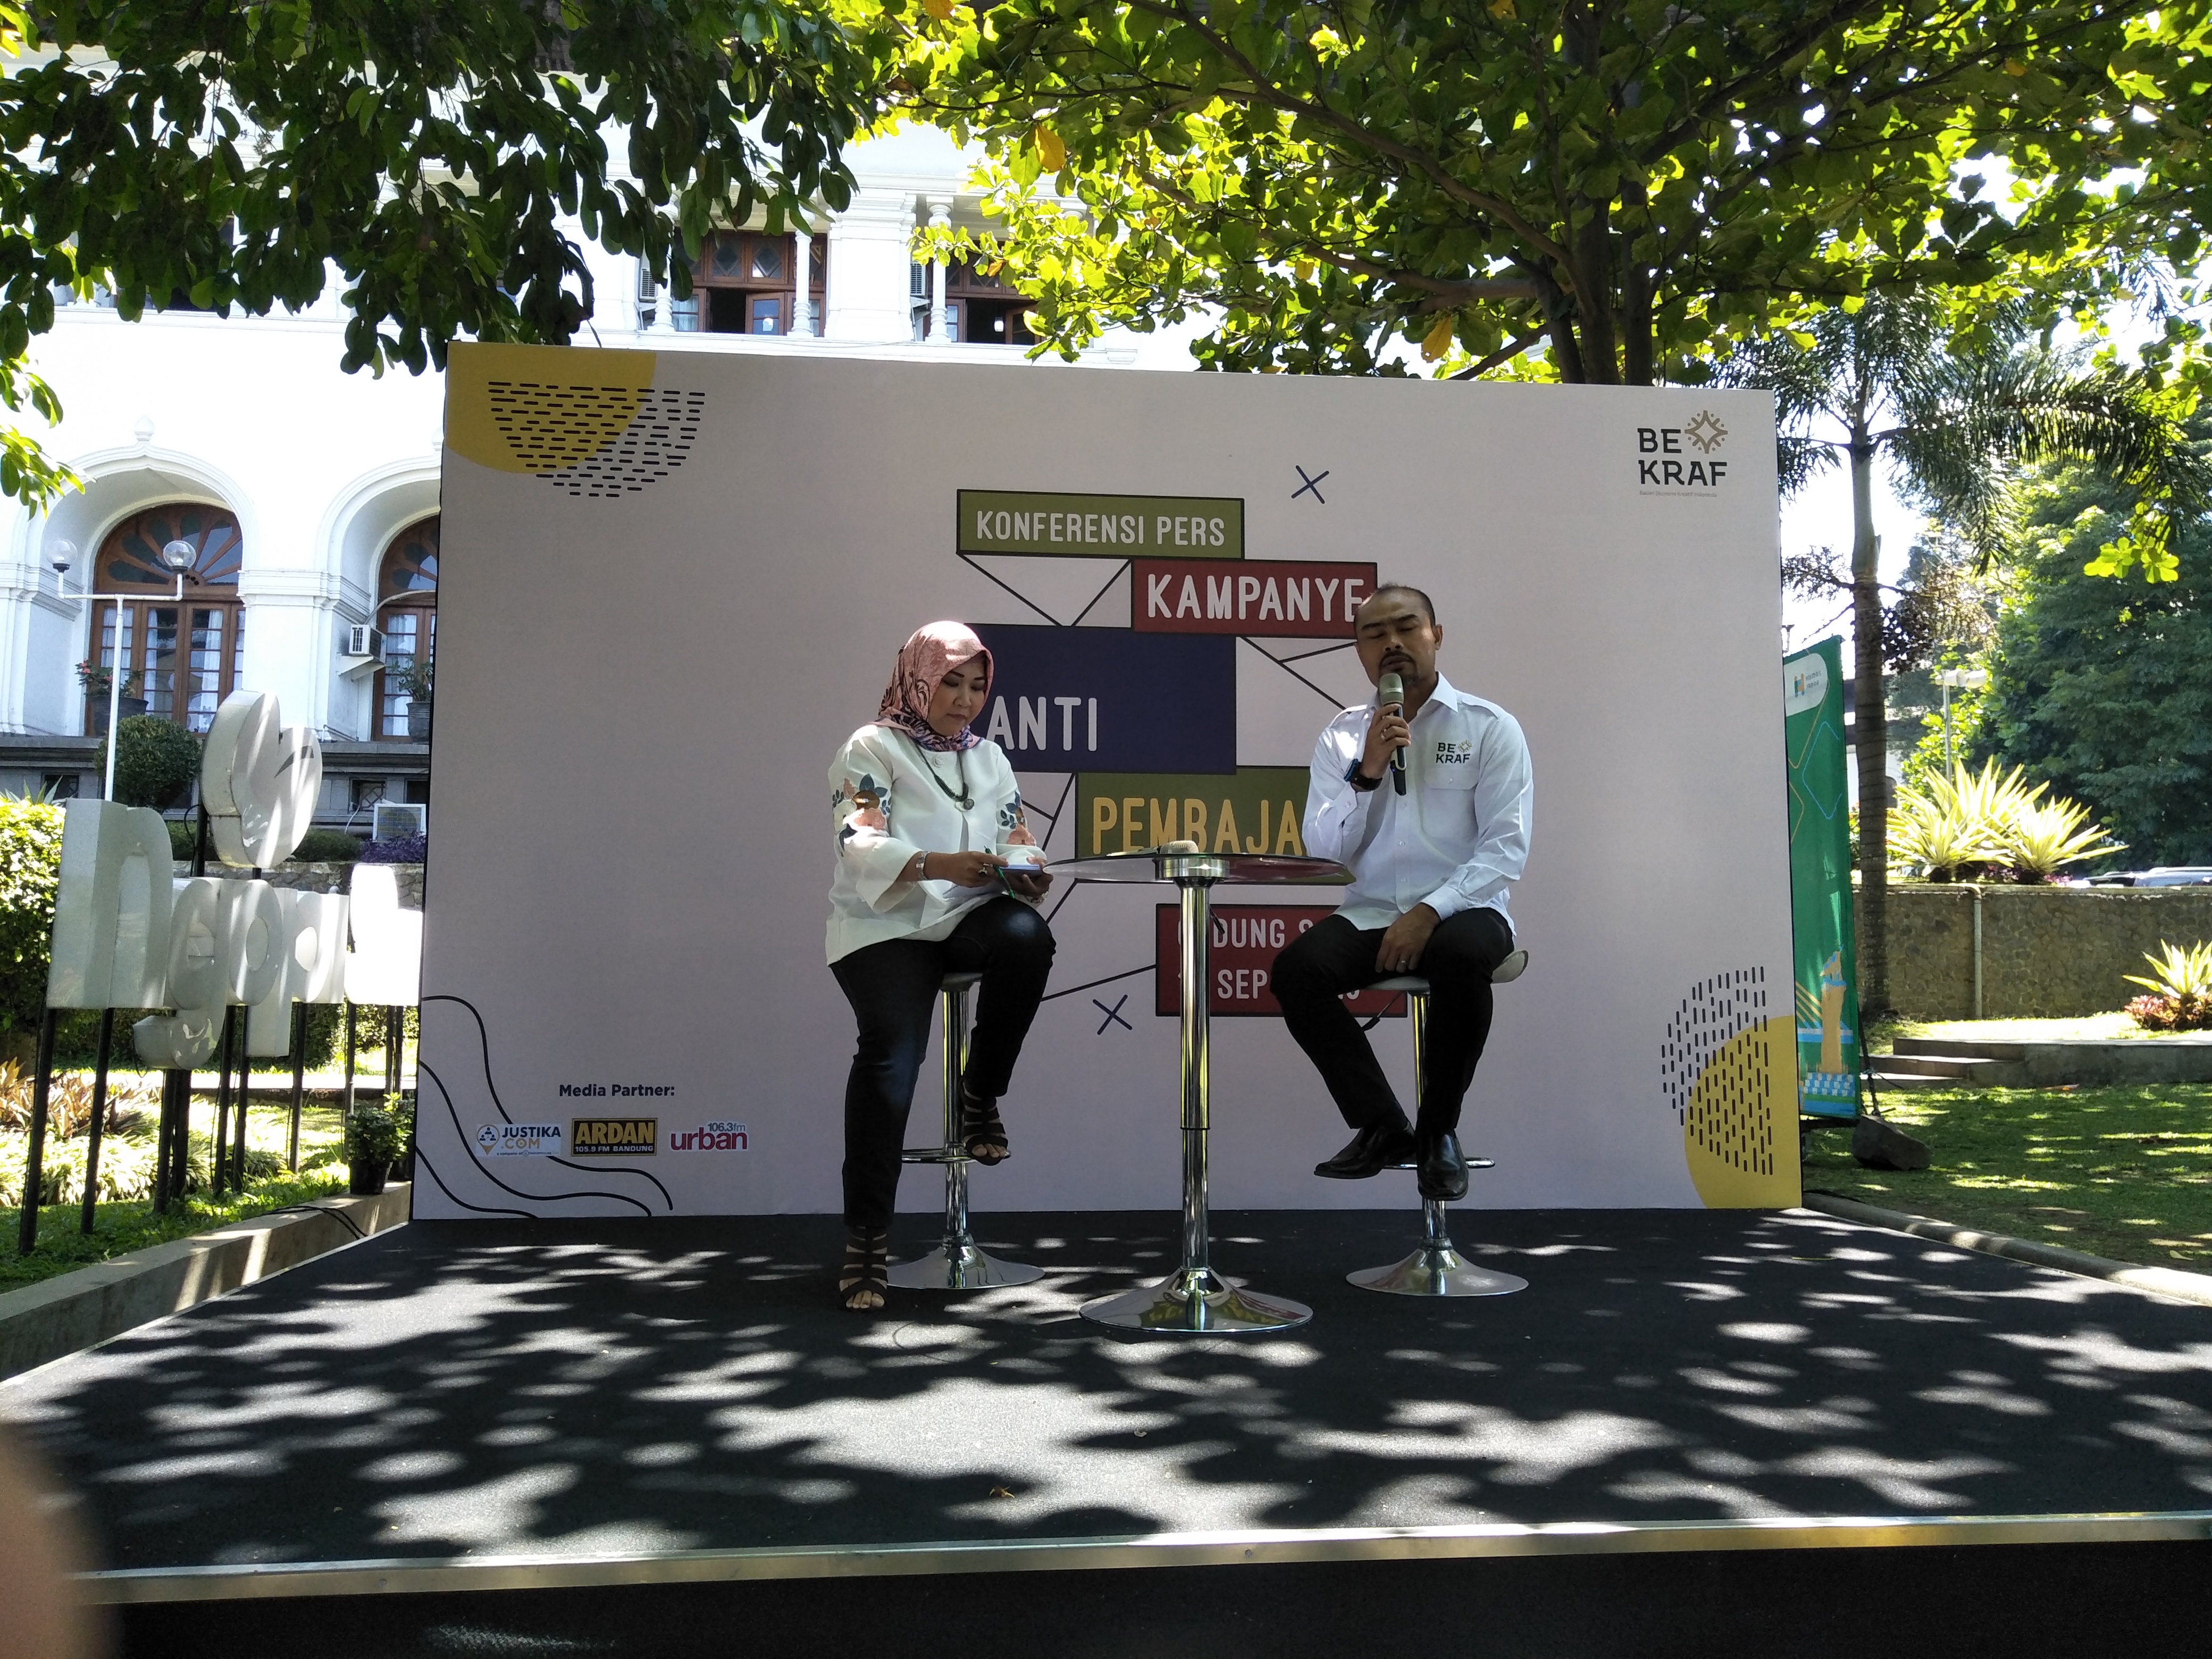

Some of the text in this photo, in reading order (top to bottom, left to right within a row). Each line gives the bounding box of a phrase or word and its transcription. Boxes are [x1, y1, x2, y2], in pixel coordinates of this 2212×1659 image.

[1637, 428, 1682, 454] BE
[1638, 460, 1728, 487] KRAF
[976, 510, 1225, 546] KONFERENSI PERS
[1147, 574, 1365, 623] KAMPANYE
[986, 696, 1097, 752] ANTI
[1436, 753, 1470, 764] KRAF
[1437, 742, 1456, 753] BE
[1093, 797, 1303, 856] PEMBAJA
[1178, 918, 1285, 949] DUNG
[559, 1084, 675, 1097] Media Partner:
[502, 1126, 561, 1138] JUSTIKA
[575, 1122, 654, 1144] ARDAN
[671, 1127, 748, 1151] urban
[708, 1122, 745, 1132] 106.3fm
